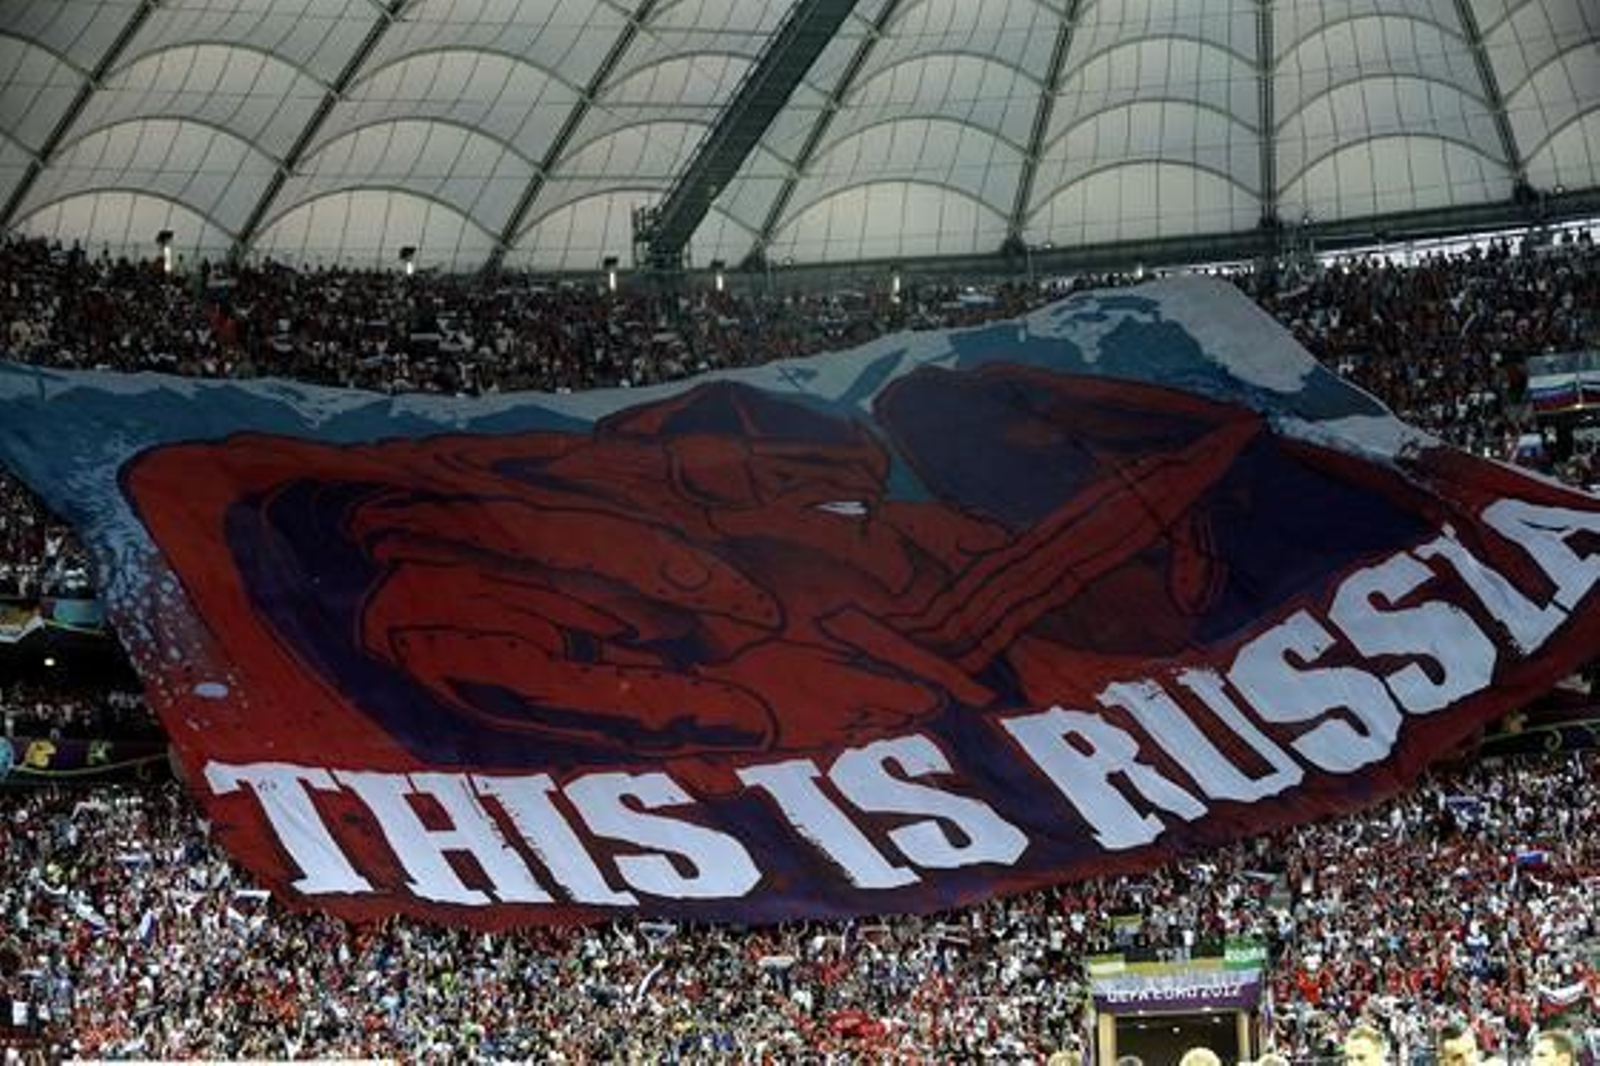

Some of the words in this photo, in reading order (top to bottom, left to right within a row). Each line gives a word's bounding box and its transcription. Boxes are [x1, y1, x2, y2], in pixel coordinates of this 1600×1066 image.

[204, 760, 762, 906] THIS
[734, 733, 1029, 889] IS
[1106, 988, 1149, 1003] UEFA
[1152, 985, 1197, 1000] EURO
[1200, 983, 1241, 999] 2012
